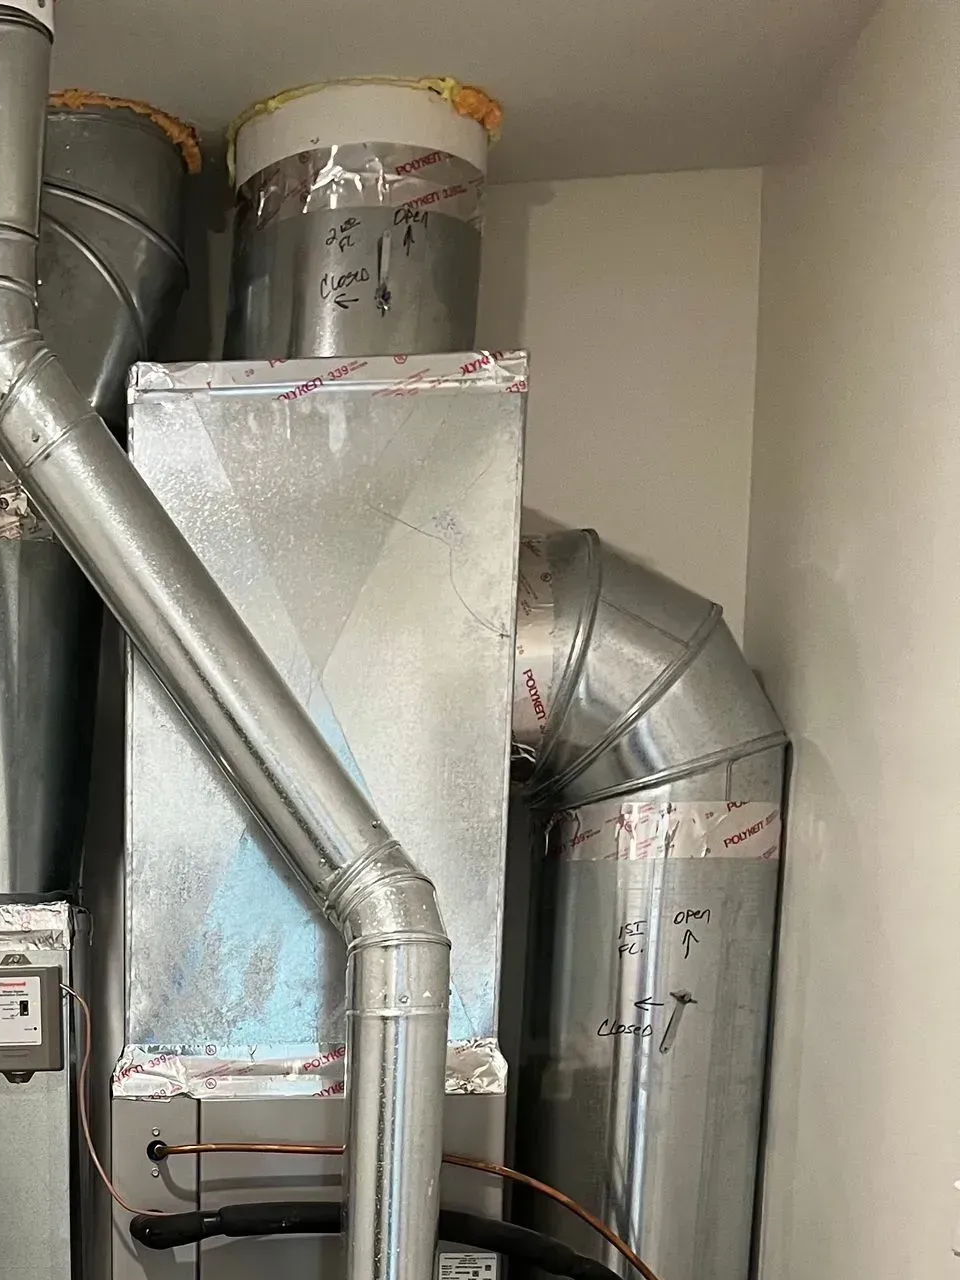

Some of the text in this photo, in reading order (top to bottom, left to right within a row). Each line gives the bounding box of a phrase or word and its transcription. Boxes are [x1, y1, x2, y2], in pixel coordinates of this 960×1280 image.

[395, 151, 443, 176] POLYKEN
[328, 364, 349, 381] 339
[522, 668, 547, 721] POLYKEN
[723, 819, 766, 849] POLYKEN
[147, 1054, 167, 1068] 339
[303, 1045, 346, 1072] POLYKE
